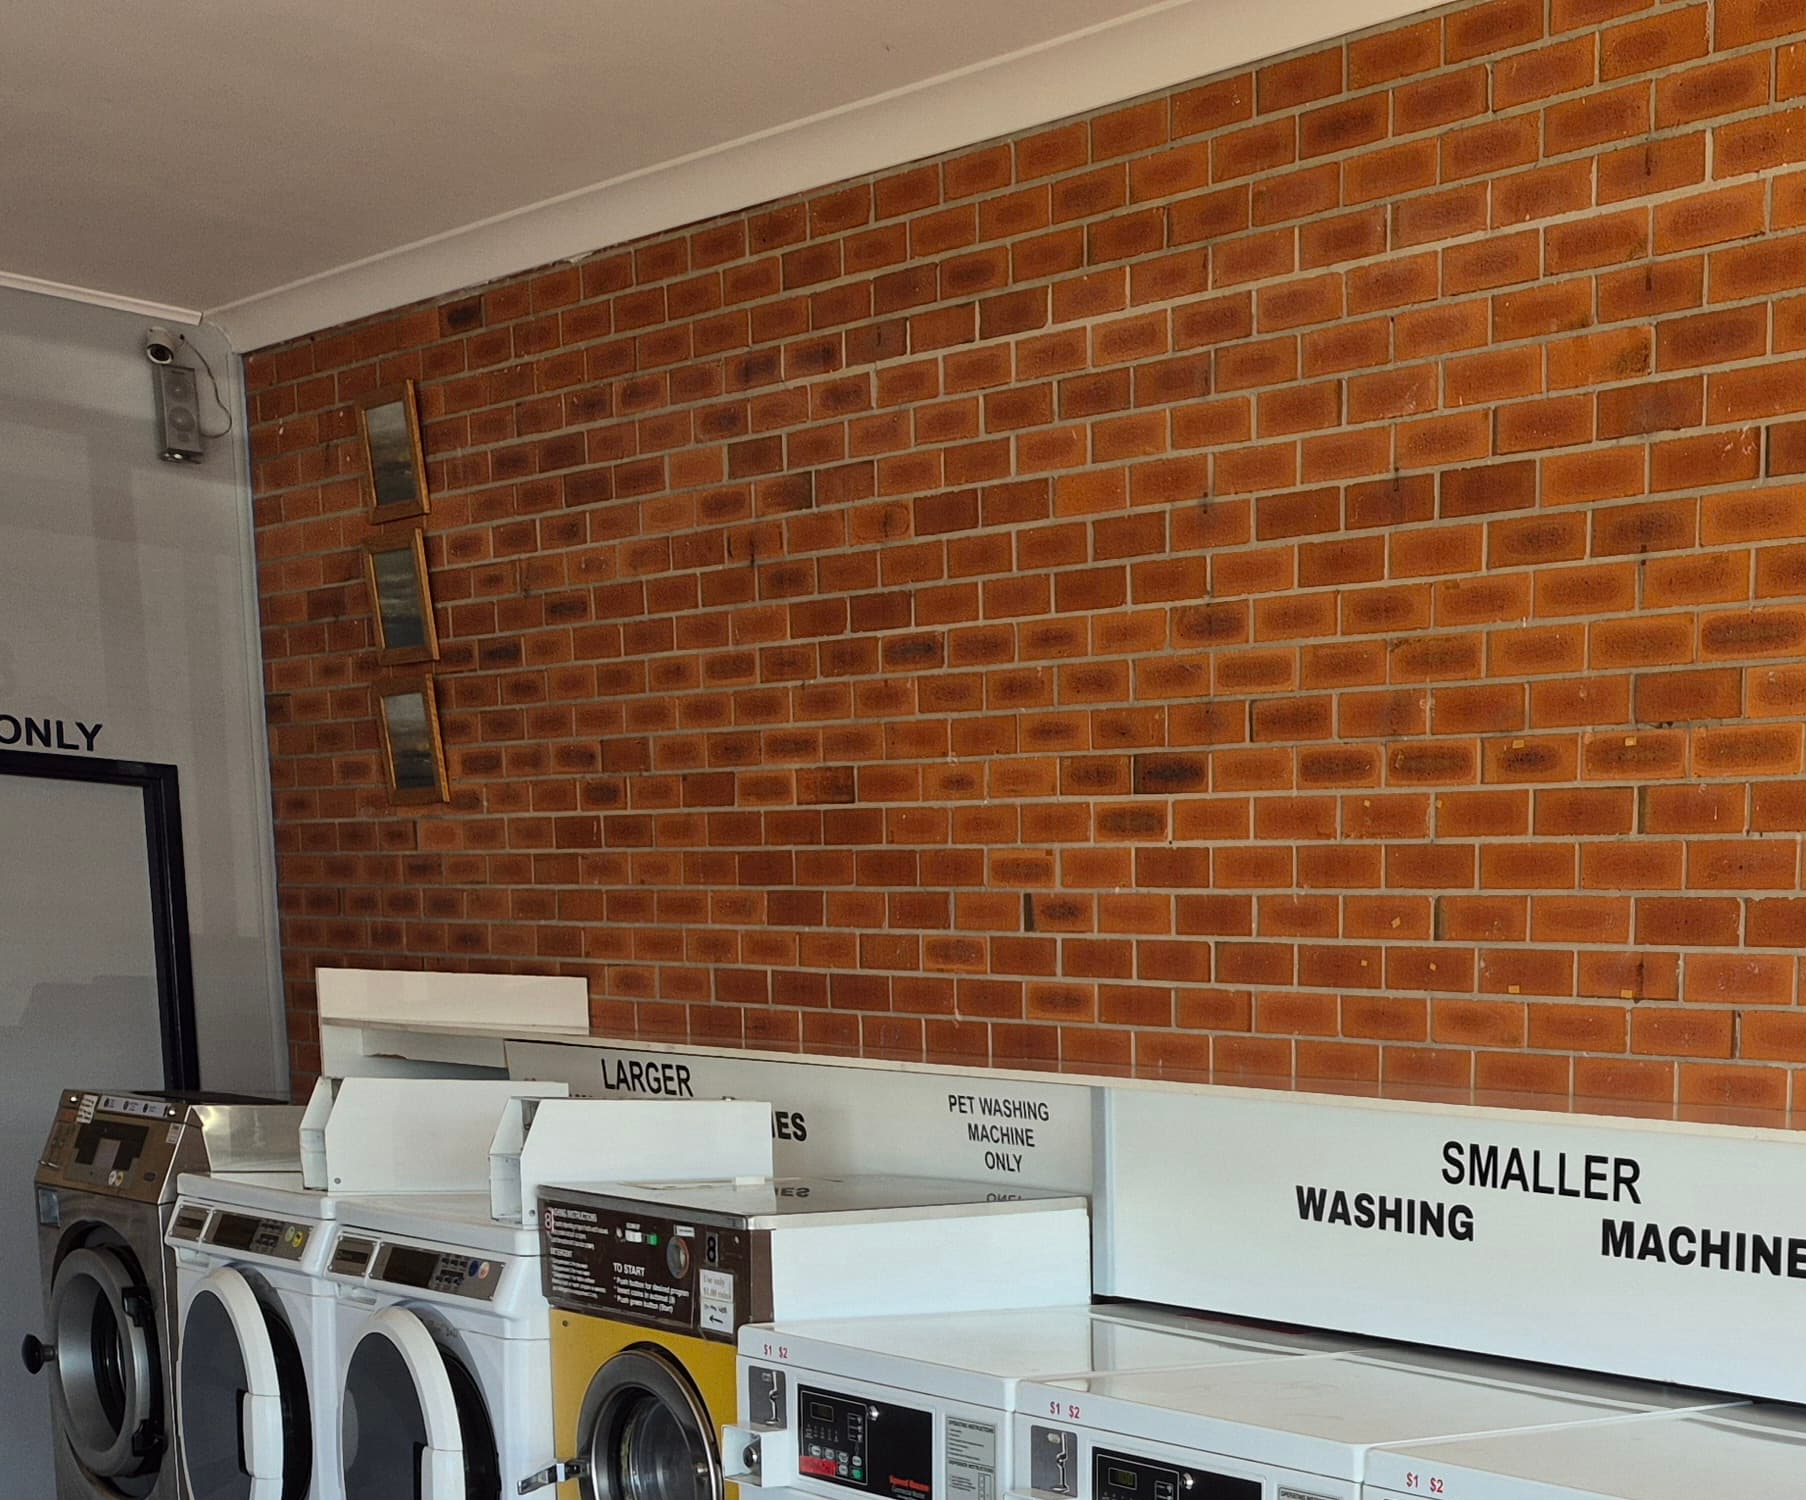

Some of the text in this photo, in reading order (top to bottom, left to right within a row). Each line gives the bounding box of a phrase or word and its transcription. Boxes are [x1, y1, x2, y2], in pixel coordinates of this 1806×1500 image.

[0, 714, 103, 752] ONLY
[601, 1058, 694, 1097] LARGER
[948, 1094, 1050, 1121] PET WASHING
[967, 1122, 1035, 1147] MACHINE
[984, 1151, 1022, 1173] ONLY
[1441, 1140, 1641, 1204] SMALLER
[1296, 1185, 1474, 1242] WASHING
[763, 1343, 788, 1359] $1 $2
[1050, 1401, 1080, 1419] $1 $2
[1406, 1471, 1444, 1493] $1 $2
